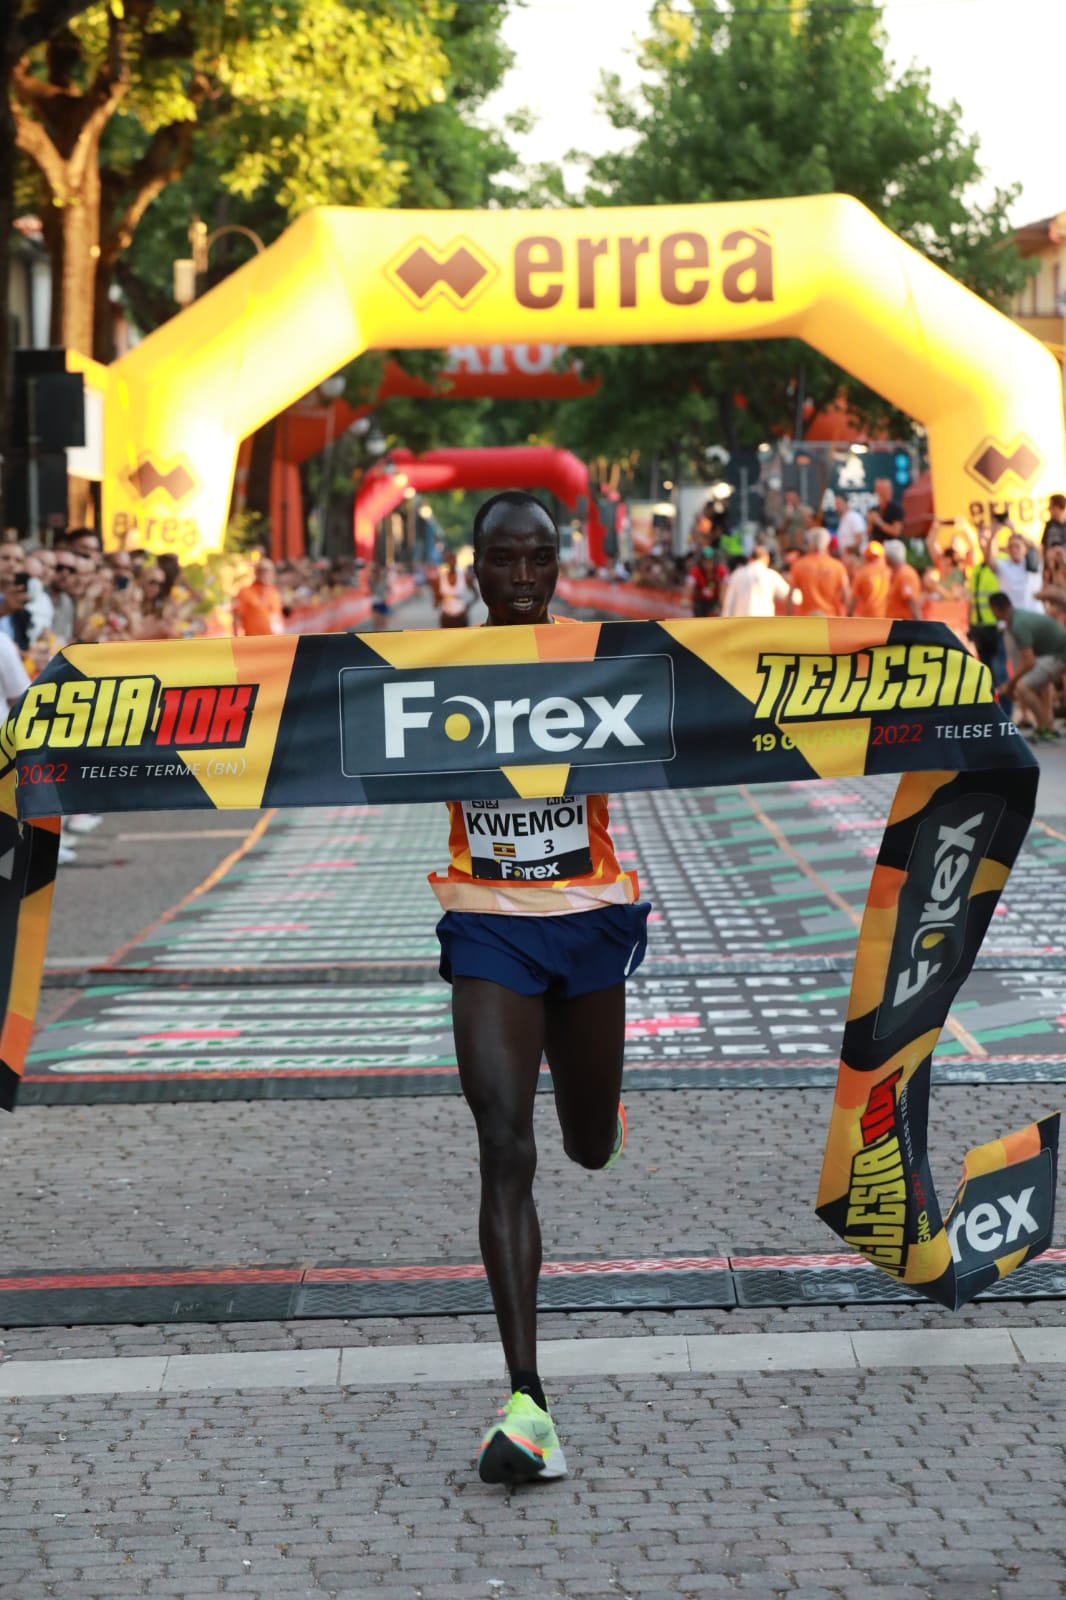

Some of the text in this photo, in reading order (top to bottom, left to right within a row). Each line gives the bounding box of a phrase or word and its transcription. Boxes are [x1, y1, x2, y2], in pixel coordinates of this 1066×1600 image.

[155, 686, 253, 746] 10K
[383, 679, 646, 759] Forex
[752, 733, 777, 752] 19
[872, 723, 923, 746] 2022
[935, 723, 994, 739] TELESE
[20, 761, 68, 786] 2022
[80, 765, 141, 779] TELESE
[145, 762, 201, 777] TERME
[466, 804, 583, 837] KWEMOI
[544, 838, 555, 855] 3
[501, 861, 561, 881] Forex
[892, 811, 985, 1008] Forex
